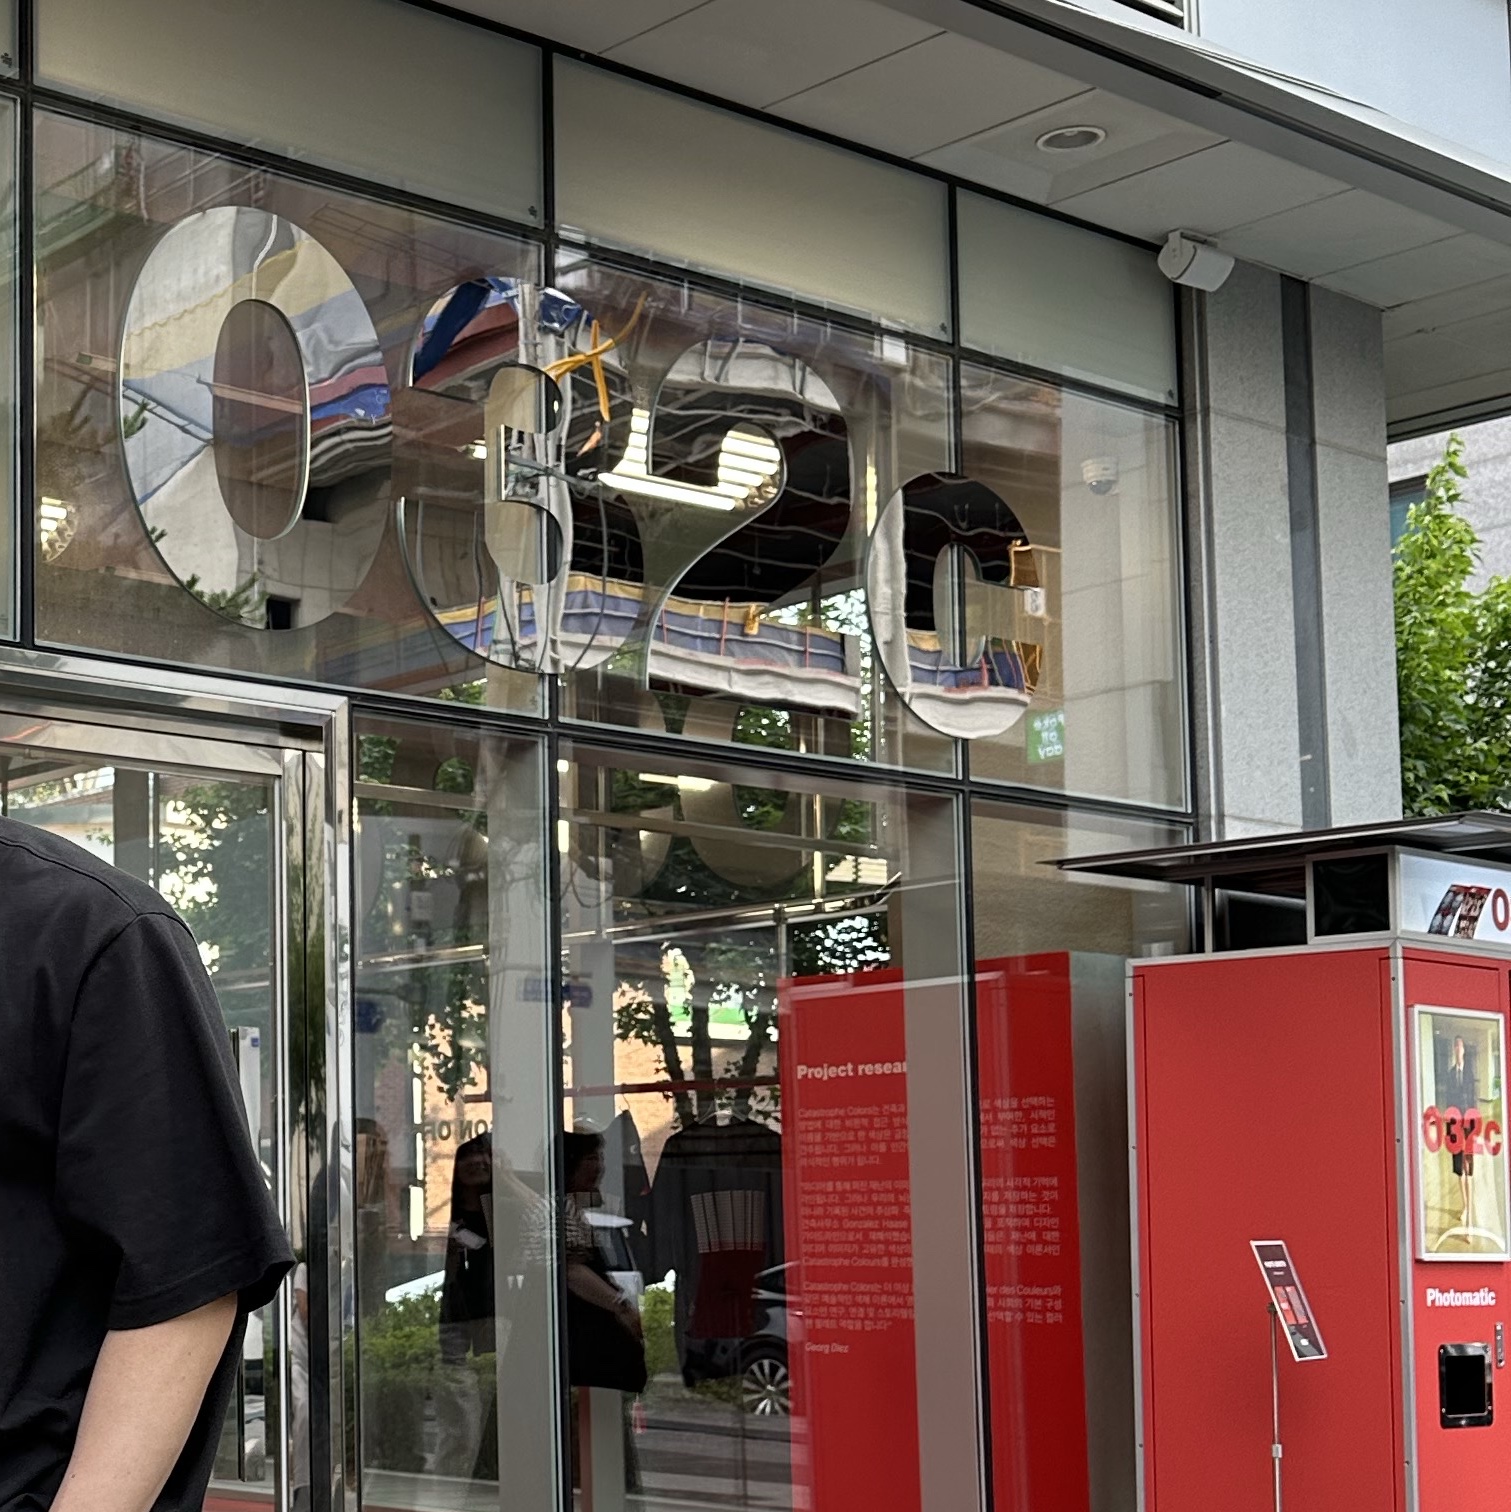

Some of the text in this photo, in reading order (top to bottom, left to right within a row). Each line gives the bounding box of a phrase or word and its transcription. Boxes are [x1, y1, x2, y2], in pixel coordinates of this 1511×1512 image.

[797, 1062, 854, 1081] Project
[1423, 1105, 1502, 1157] 032c
[1425, 1286, 1497, 1307] Photomatic
